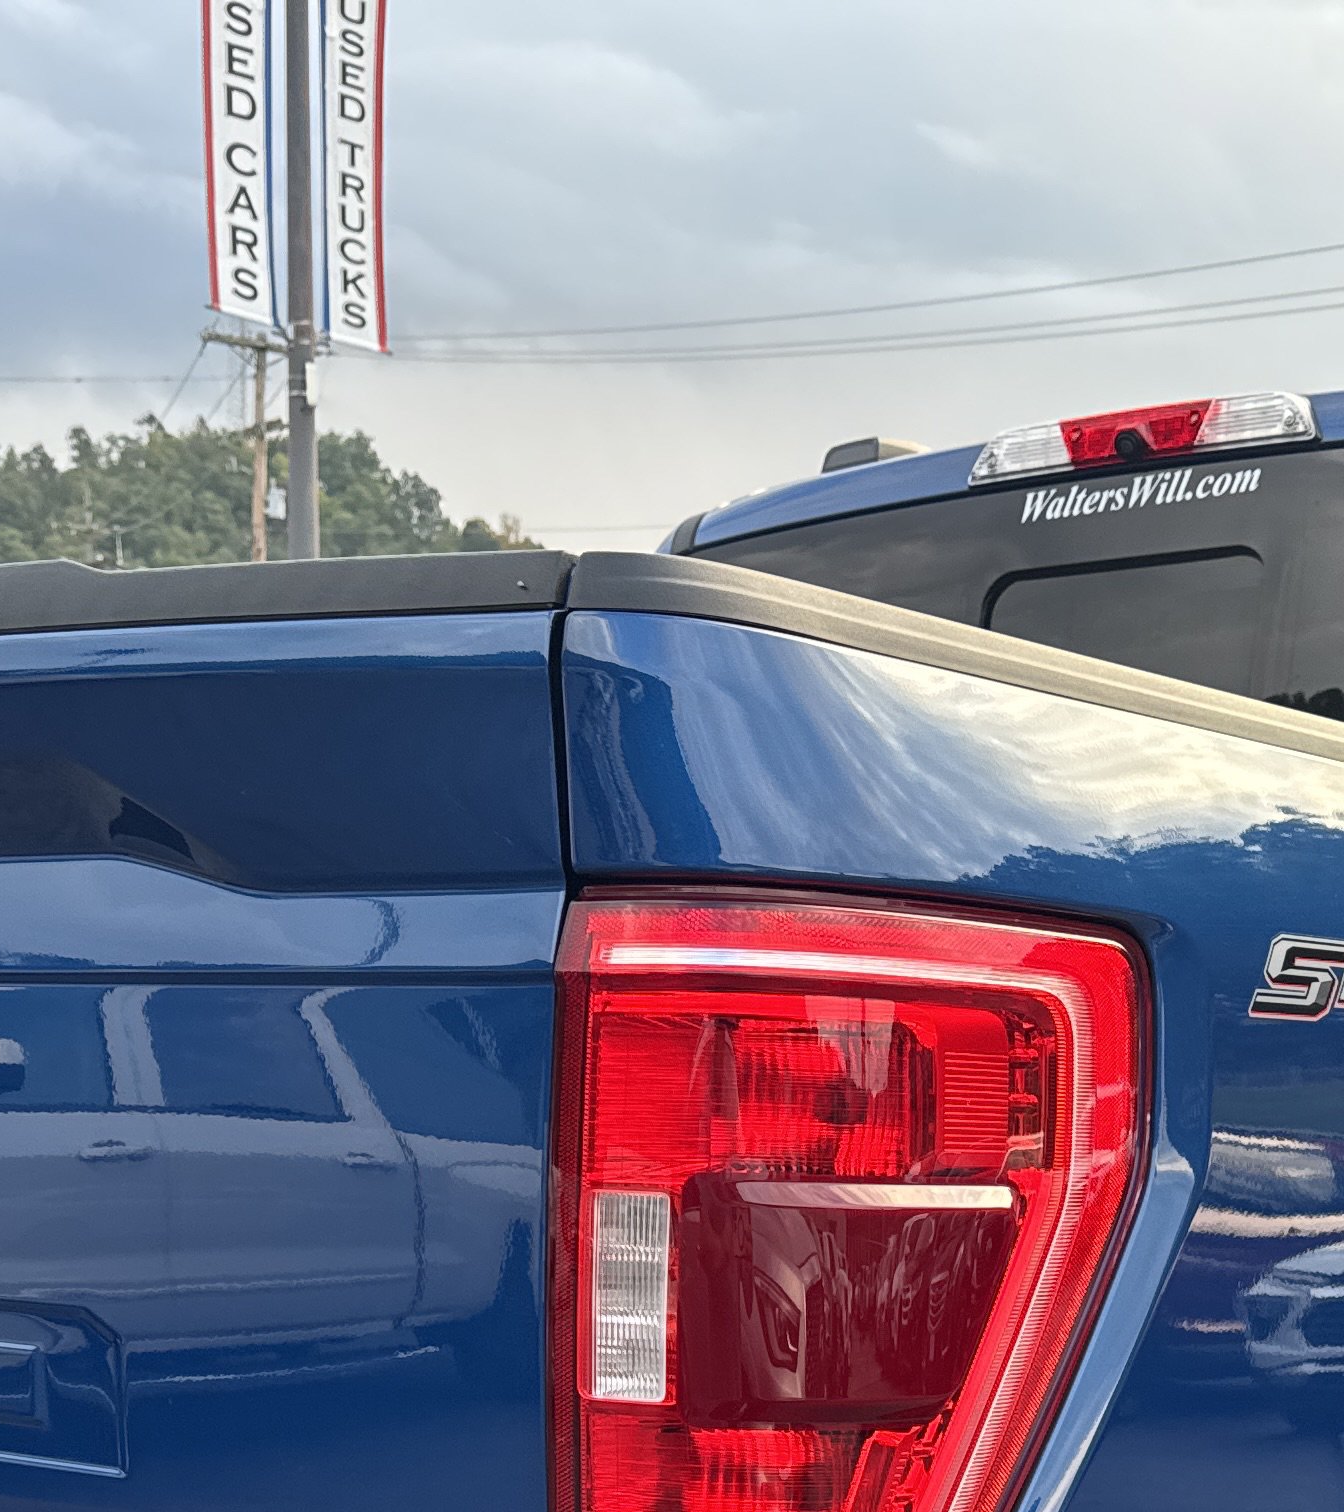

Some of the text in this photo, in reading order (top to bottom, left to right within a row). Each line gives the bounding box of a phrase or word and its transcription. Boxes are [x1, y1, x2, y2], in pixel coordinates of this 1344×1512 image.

[225, 142, 258, 301] CARS
[338, 0, 366, 330] USED TRUCKS
[1020, 467, 1262, 525] WaltersWill.com
